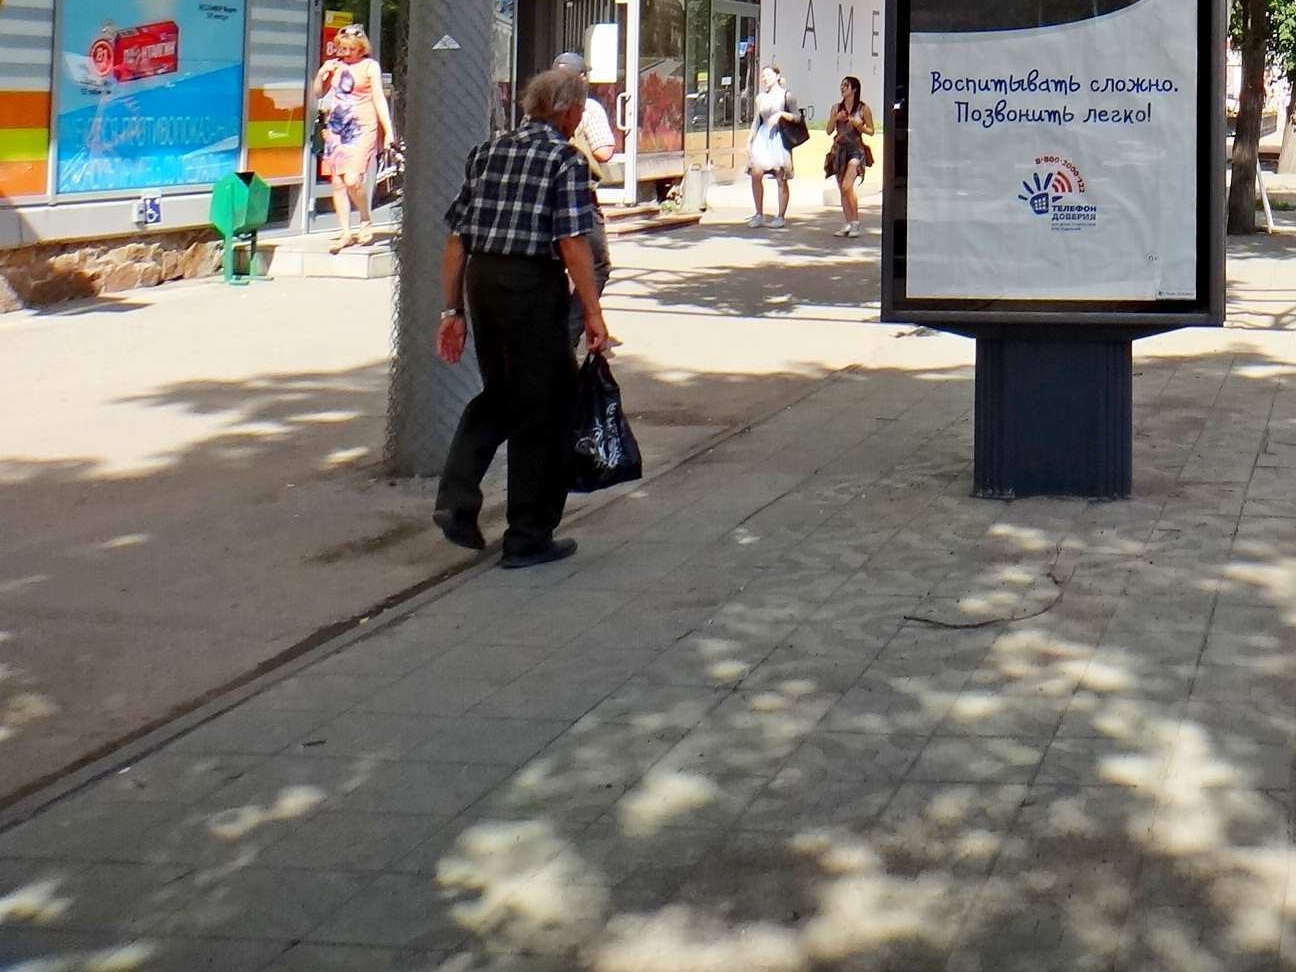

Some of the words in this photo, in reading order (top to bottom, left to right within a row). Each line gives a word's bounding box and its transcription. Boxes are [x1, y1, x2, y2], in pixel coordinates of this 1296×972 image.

[930, 69, 1081, 96] Воспитывать
[1090, 77, 1178, 94] сложно.
[955, 99, 1075, 129] Позвонить
[1083, 102, 1151, 124] легко!
[1051, 205, 1097, 213] ТЕЛЕФОН
[1051, 213, 1097, 221] ДОВЕРИЯ
